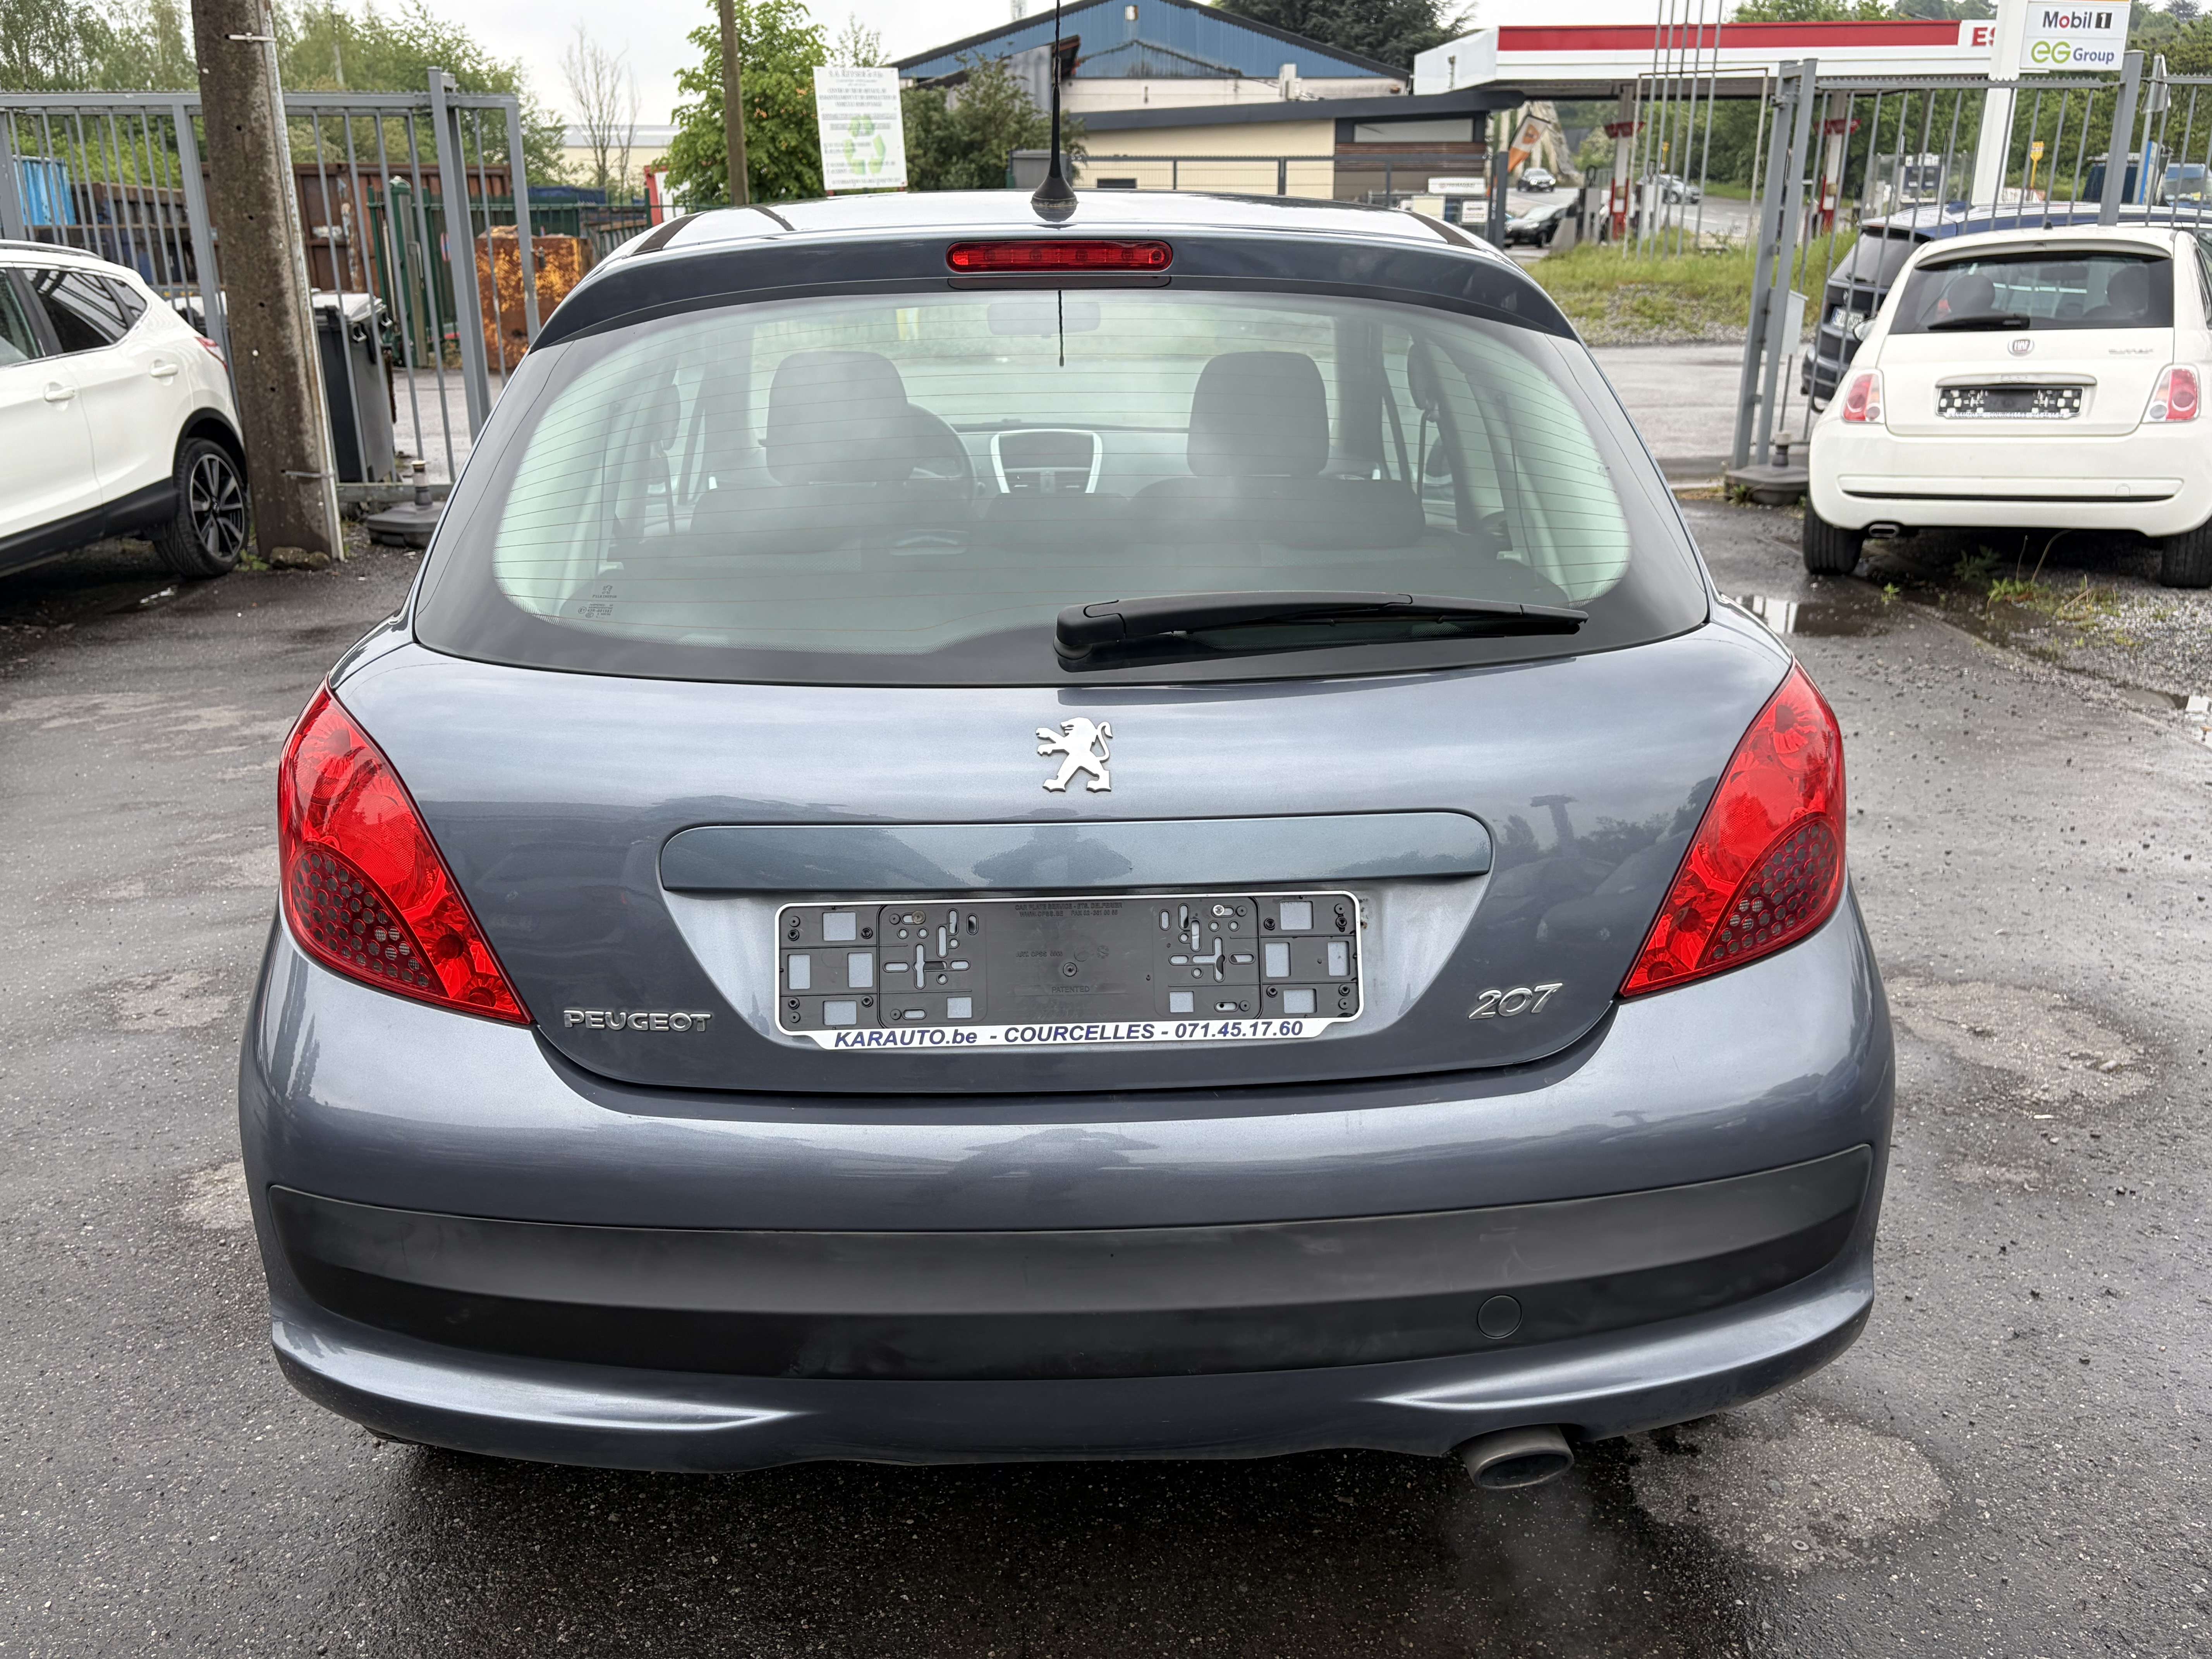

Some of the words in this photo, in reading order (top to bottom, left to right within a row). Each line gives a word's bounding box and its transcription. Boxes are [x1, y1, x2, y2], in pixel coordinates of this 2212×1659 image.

[2042, 11, 2092, 28] Mobil
[2073, 47, 2115, 65] Group
[1468, 983, 1563, 1019] 207
[563, 1010, 712, 1032] PEUGEOT
[835, 1029, 977, 1047] KARAUTO.be
[1005, 1024, 1154, 1042] COURCELLES
[1175, 1021, 1303, 1038] 071.45.17.60
